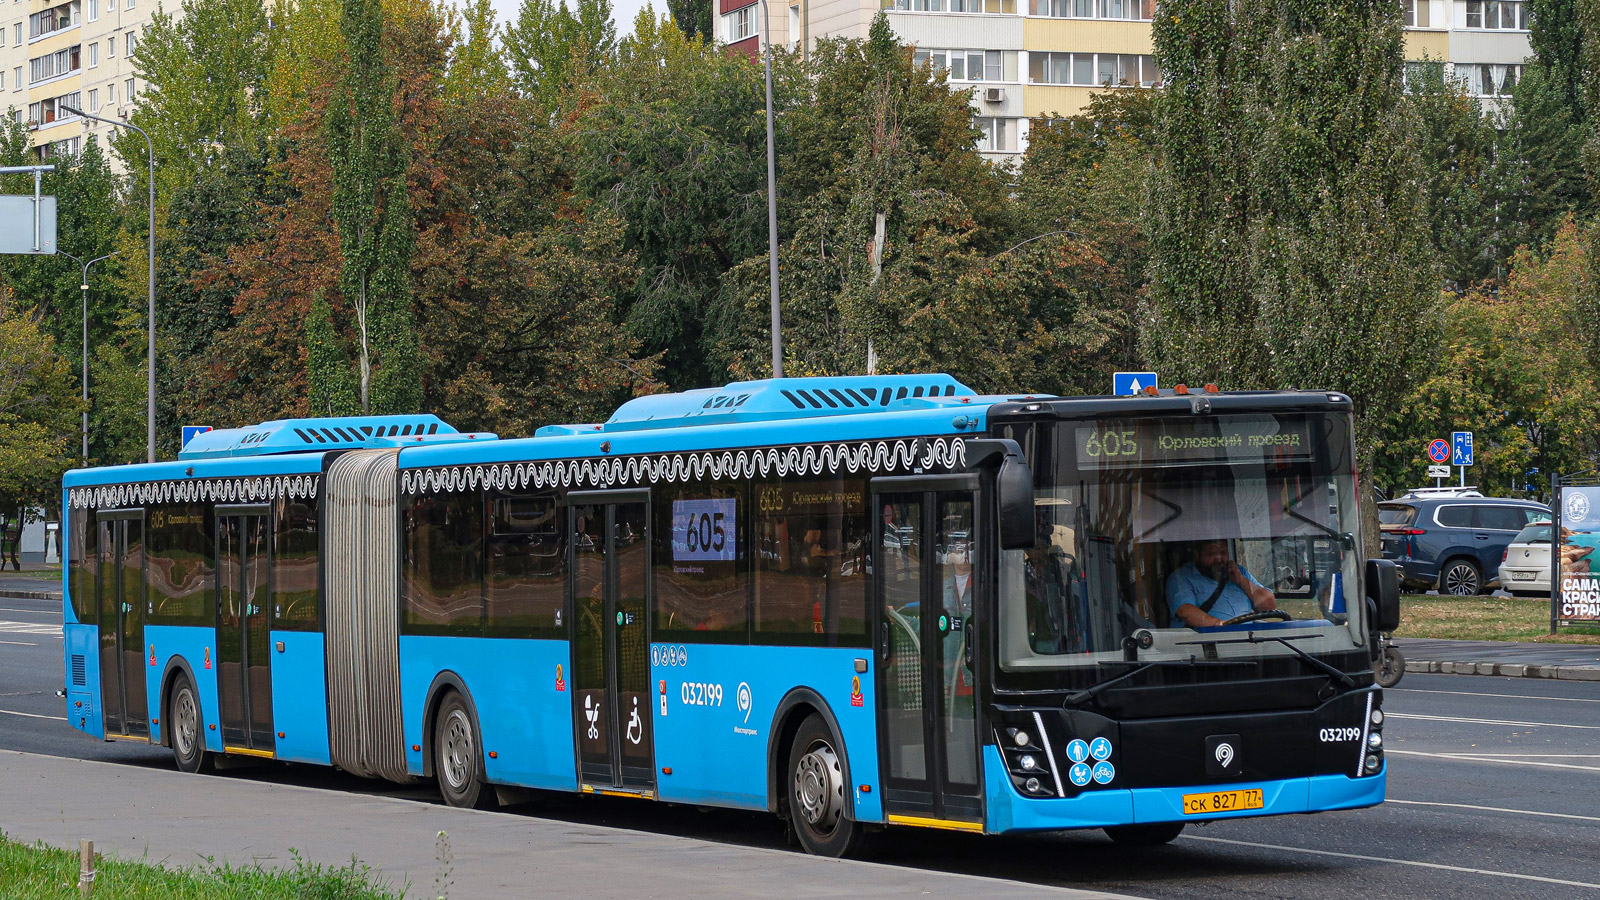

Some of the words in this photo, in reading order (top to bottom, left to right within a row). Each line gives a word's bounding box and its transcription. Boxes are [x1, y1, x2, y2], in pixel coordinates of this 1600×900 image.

[1086, 430, 1138, 457] 605
[1159, 433, 1242, 450] Юрловский
[1248, 433, 1300, 448] проезд
[760, 487, 784, 511] 605
[151, 511, 164, 528] 605
[686, 512, 725, 552] 605
[1563, 578, 1600, 591] САМА
[681, 682, 723, 707] 032199
[1319, 727, 1361, 743] 032199
[1213, 793, 1237, 809] 827
[1245, 791, 1258, 802] 77
